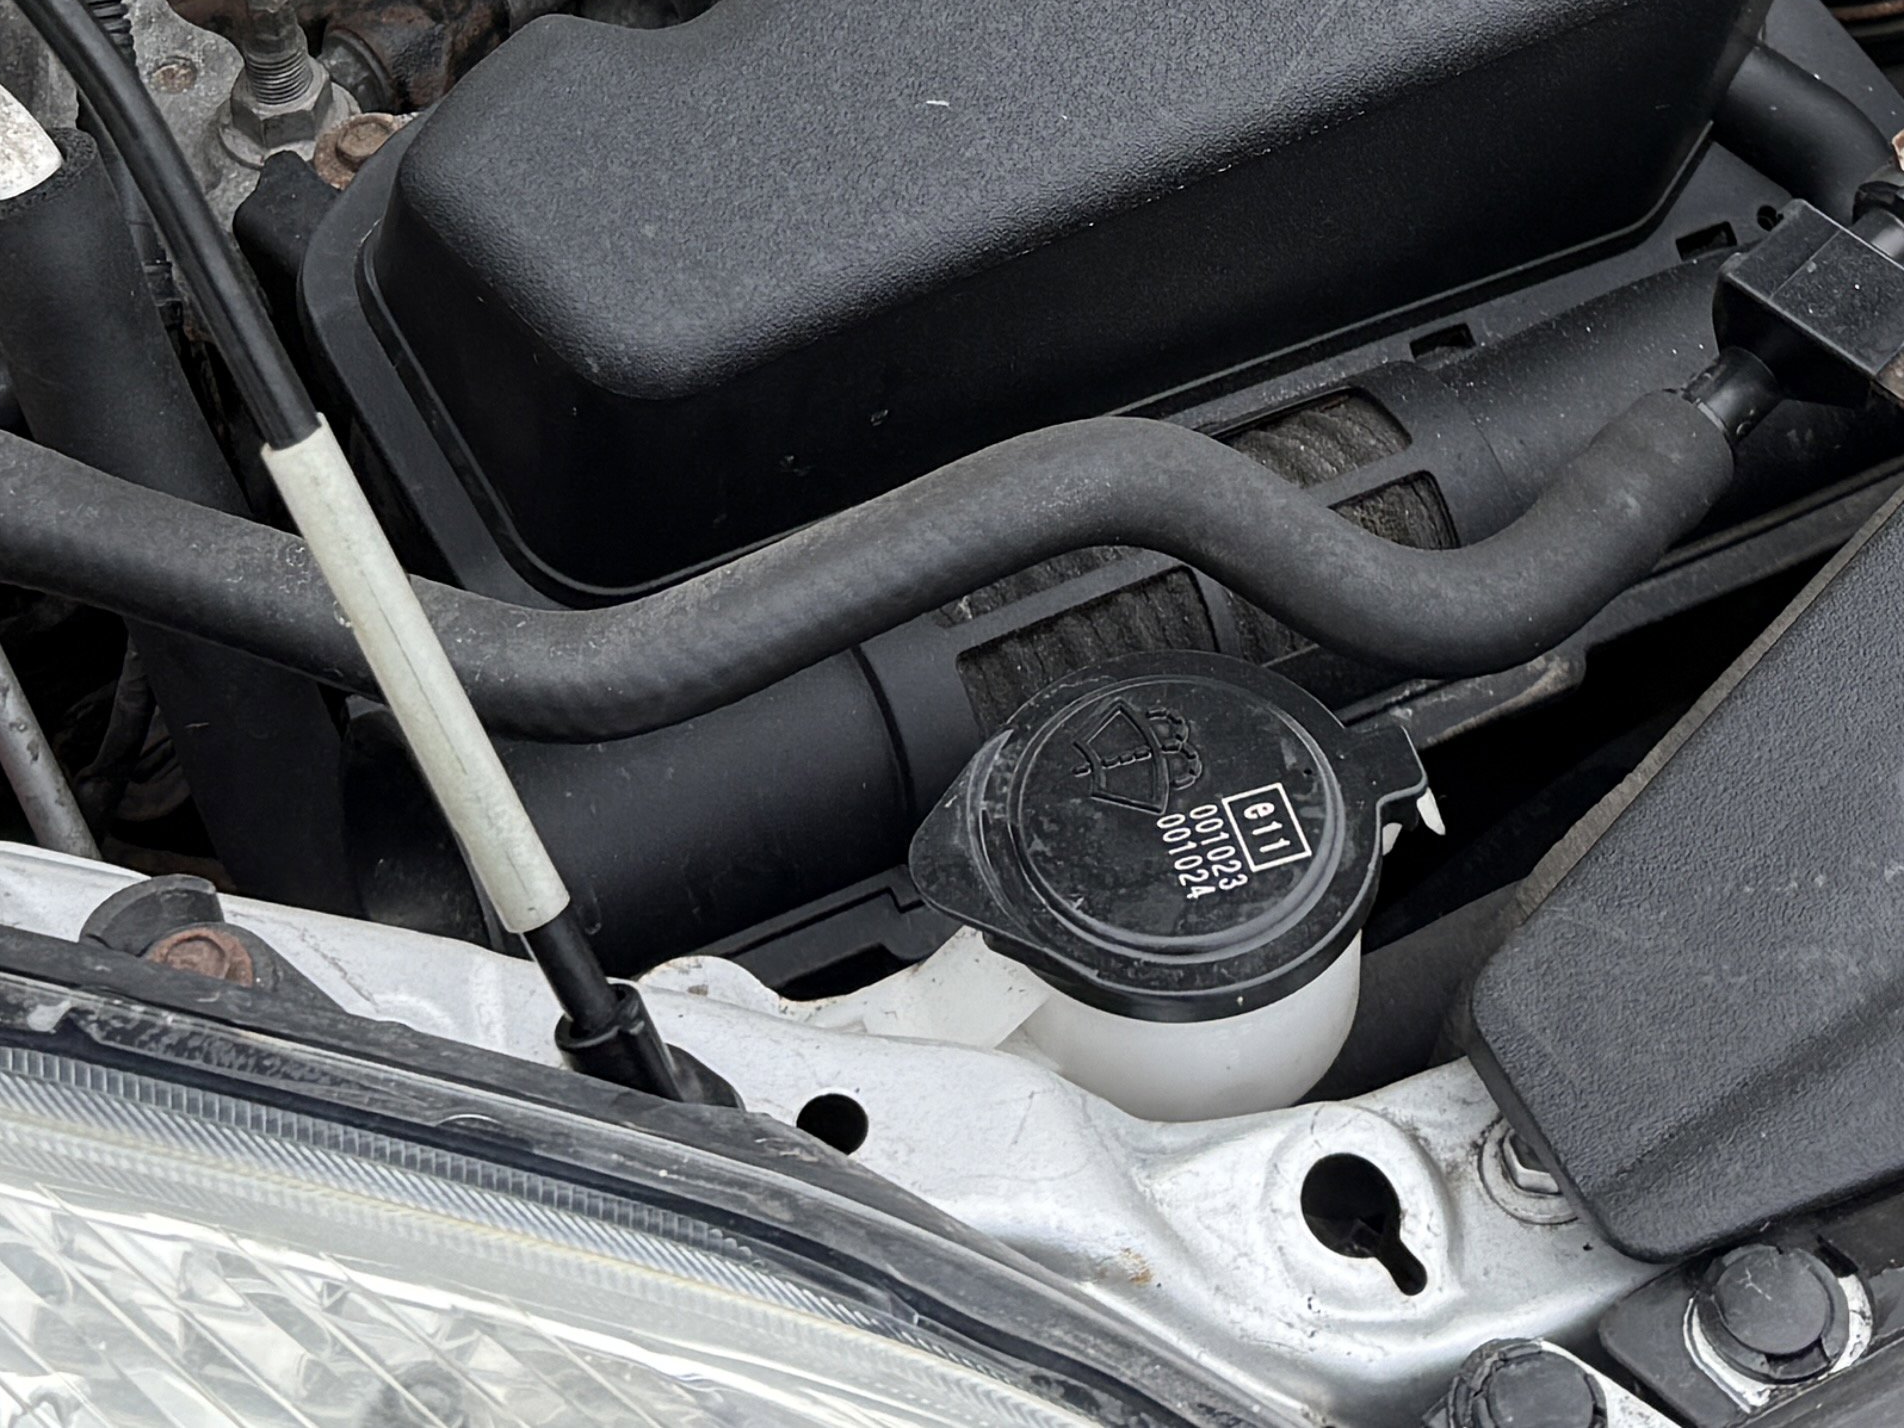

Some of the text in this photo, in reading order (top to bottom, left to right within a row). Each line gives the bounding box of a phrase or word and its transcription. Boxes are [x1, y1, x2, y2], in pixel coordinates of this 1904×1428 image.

[1157, 813, 1211, 901] 001024
[1190, 804, 1249, 891] 001023
[1243, 802, 1290, 854] e11
